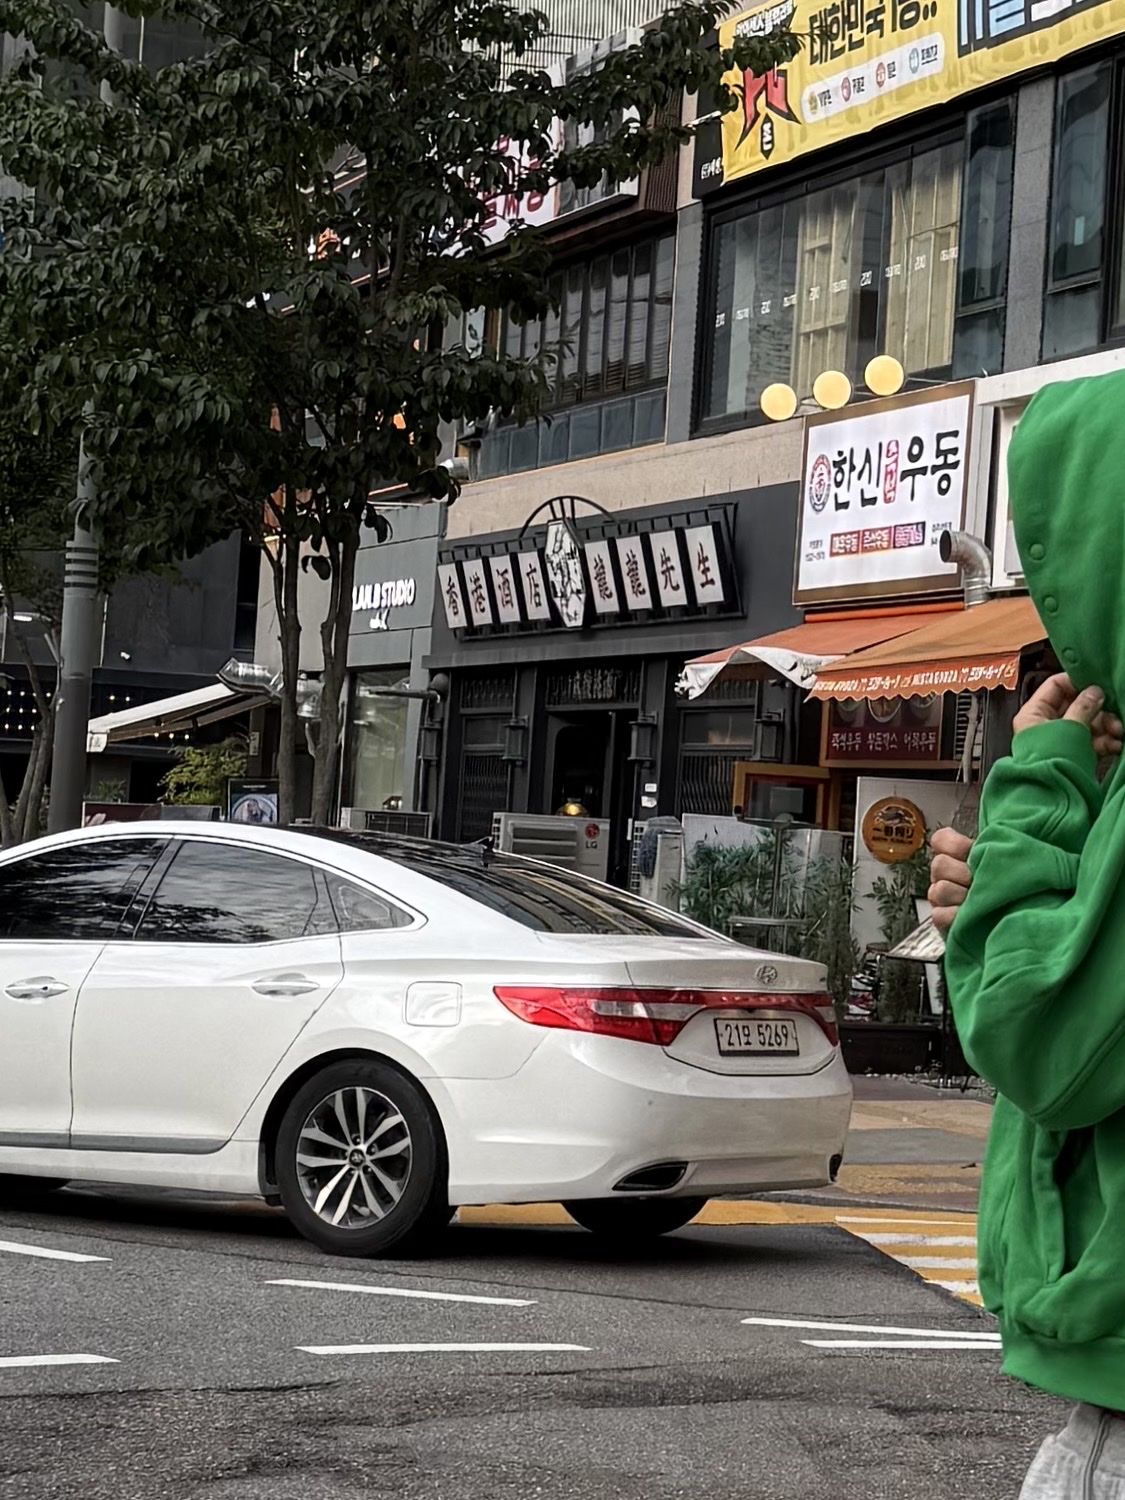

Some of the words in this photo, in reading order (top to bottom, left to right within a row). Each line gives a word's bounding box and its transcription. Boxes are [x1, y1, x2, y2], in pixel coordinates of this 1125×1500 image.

[832, 441, 883, 512] 한신
[900, 430, 961, 502] 우동
[585, 840, 598, 849] LG
[757, 1023, 789, 1047] 5269
